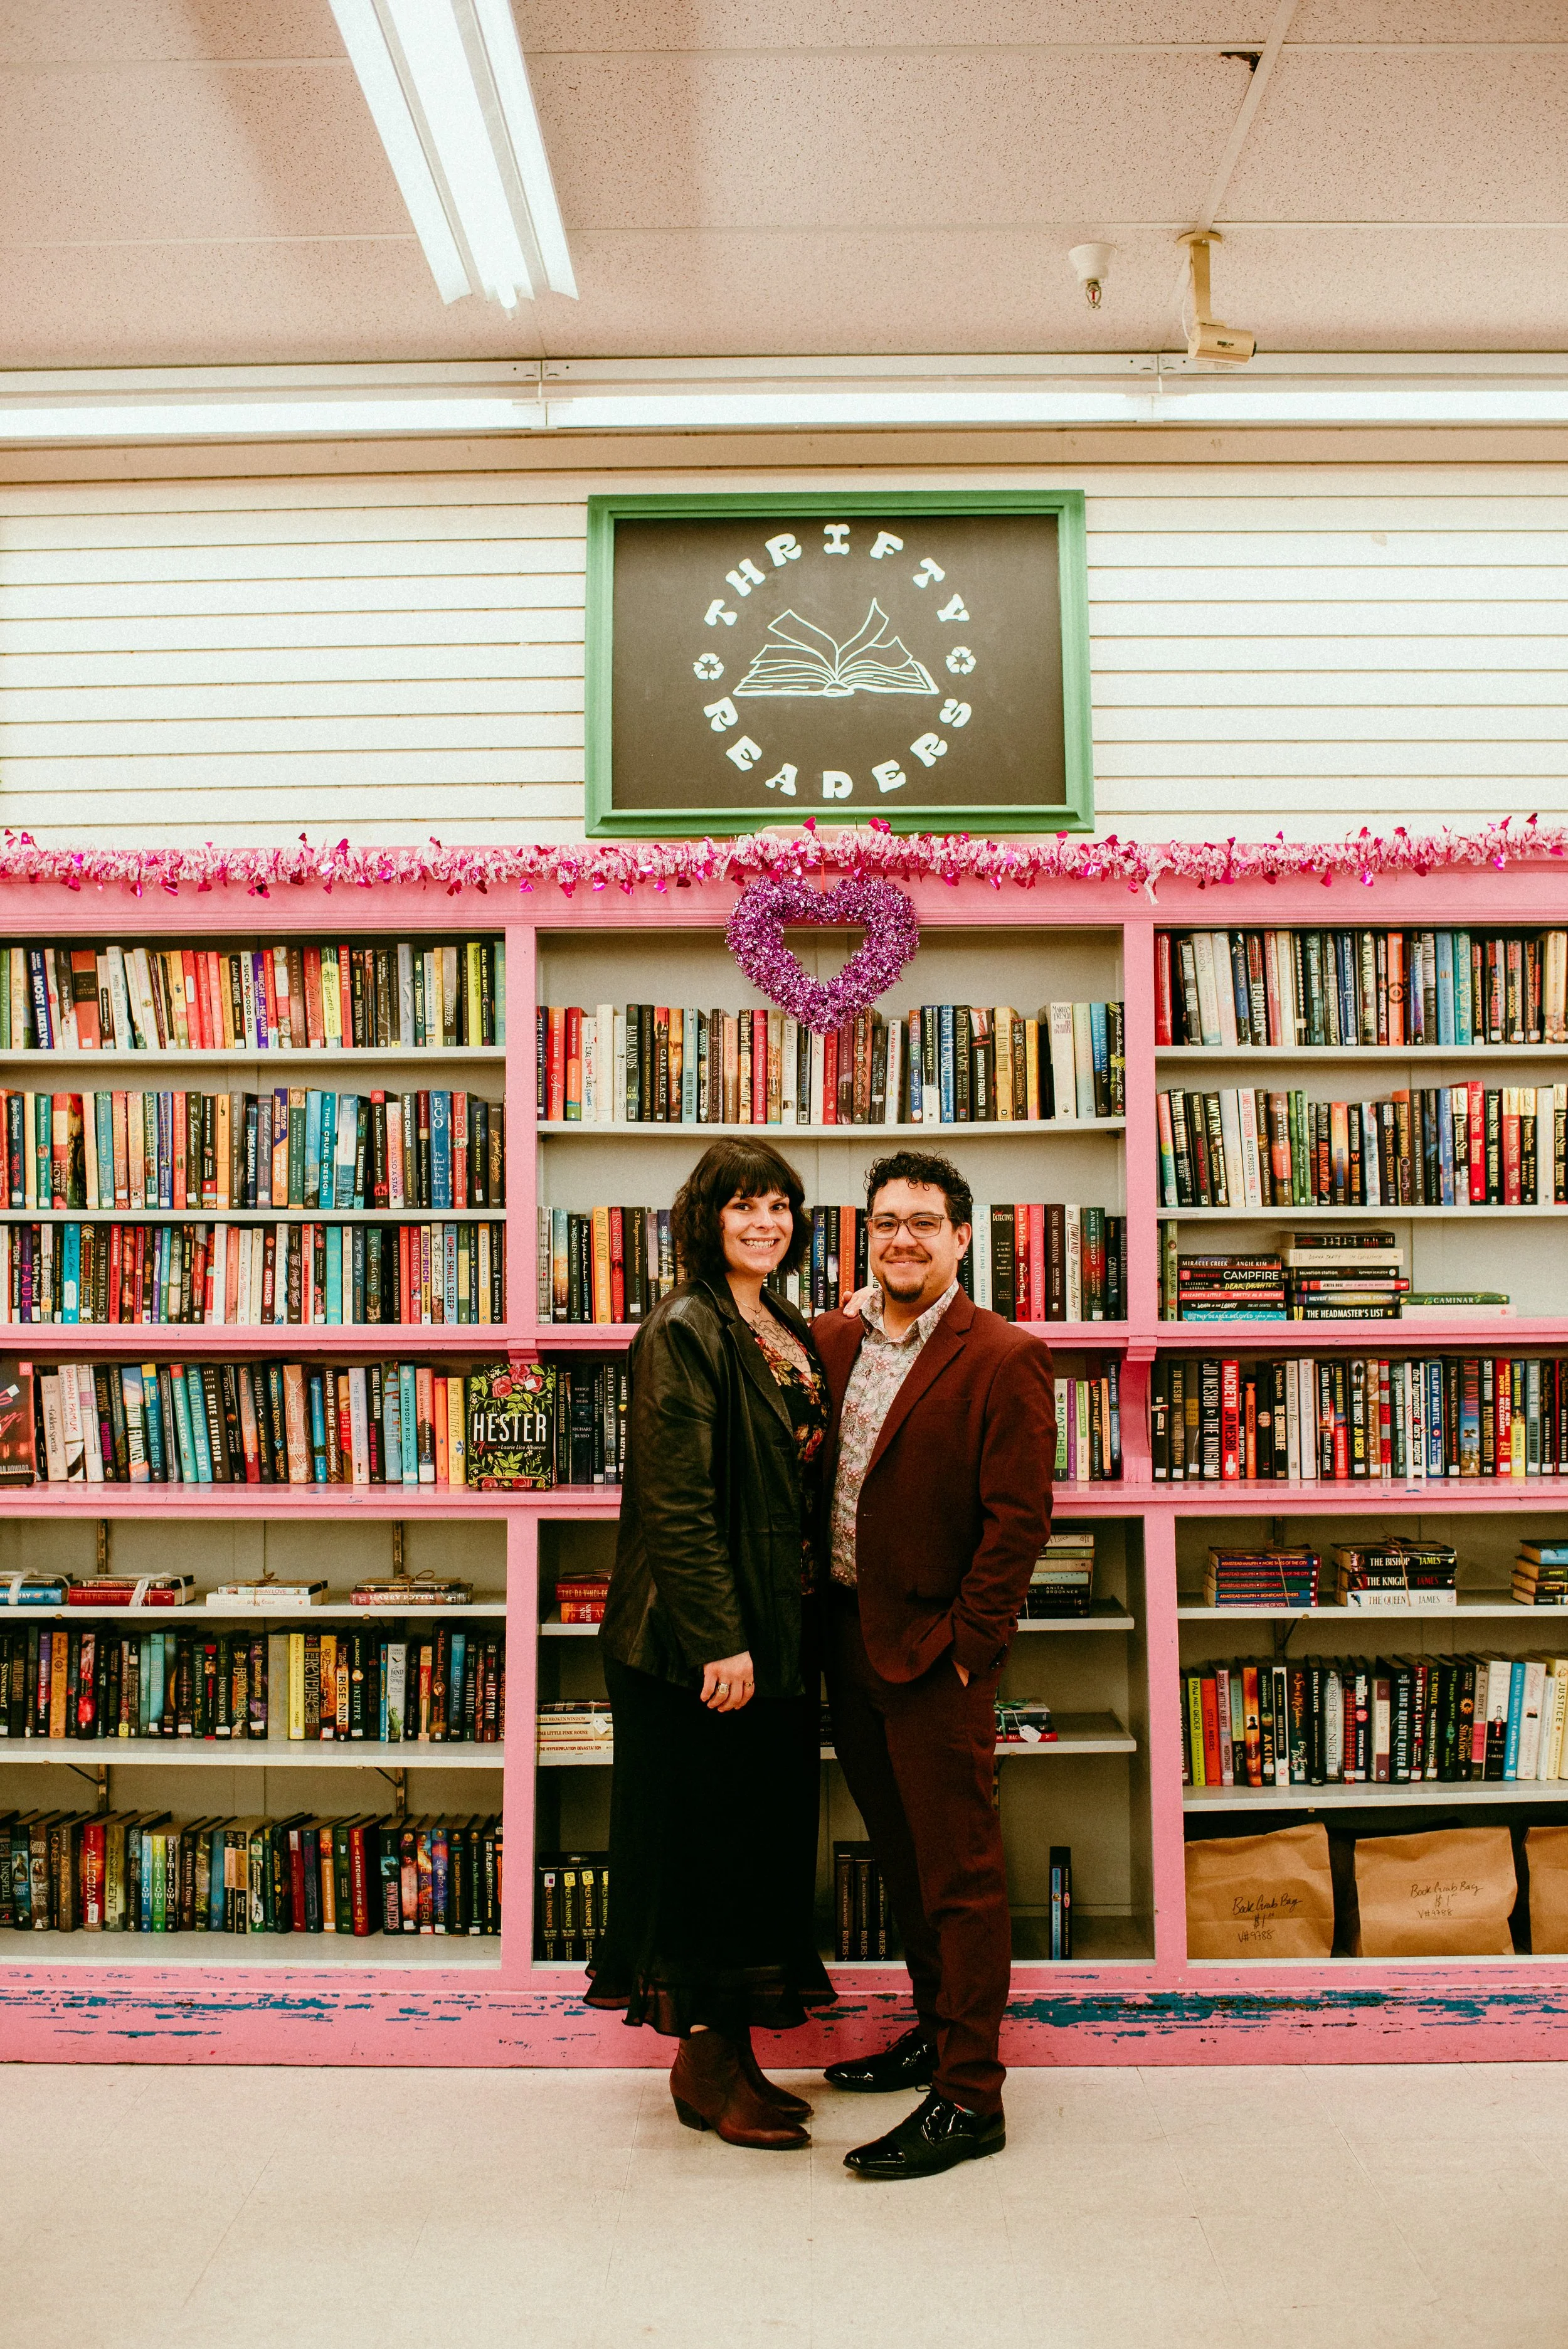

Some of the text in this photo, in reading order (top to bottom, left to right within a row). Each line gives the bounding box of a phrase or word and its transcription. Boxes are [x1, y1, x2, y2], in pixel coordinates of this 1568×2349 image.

[704, 522, 970, 627] THRIFTY
[703, 697, 972, 799] READERS
[33, 975, 48, 1039] MOST LIKELY
[627, 1026, 637, 1069] BADLANDS
[247, 1130, 256, 1184] DREAMFALL
[1385, 1128, 1393, 1153] Short
[596, 1211, 607, 1260] ONE BLOOD
[1108, 1257, 1116, 1286] GRANTED
[1224, 1271, 1279, 1280] CAMPFIRE
[1321, 1309, 1369, 1318] HEADMASTER'S
[1370, 1309, 1384, 1317] LIST
[1224, 1365, 1236, 1450] MACBETH JO NESBØ
[100, 1422, 112, 1461] INSIDIOUS
[147, 1409, 160, 1468] DARLING GIRLS
[207, 1394, 221, 1461] KATE ATKINSON
[474, 1413, 546, 1442] HESTER
[1385, 1557, 1410, 1566] BISHOP
[1419, 1557, 1441, 1565] JAMES
[1384, 1596, 1406, 1605] QUEEN
[218, 1677, 226, 1723] INQUISITION
[485, 1683, 495, 1719] LAST STAR
[1555, 1682, 1565, 1722] JUSTICE
[1232, 1897, 1255, 1915] Book
[1281, 1893, 1303, 1912] Bag
[1411, 1884, 1431, 1897] Book
[1459, 1881, 1483, 1896] Bag
